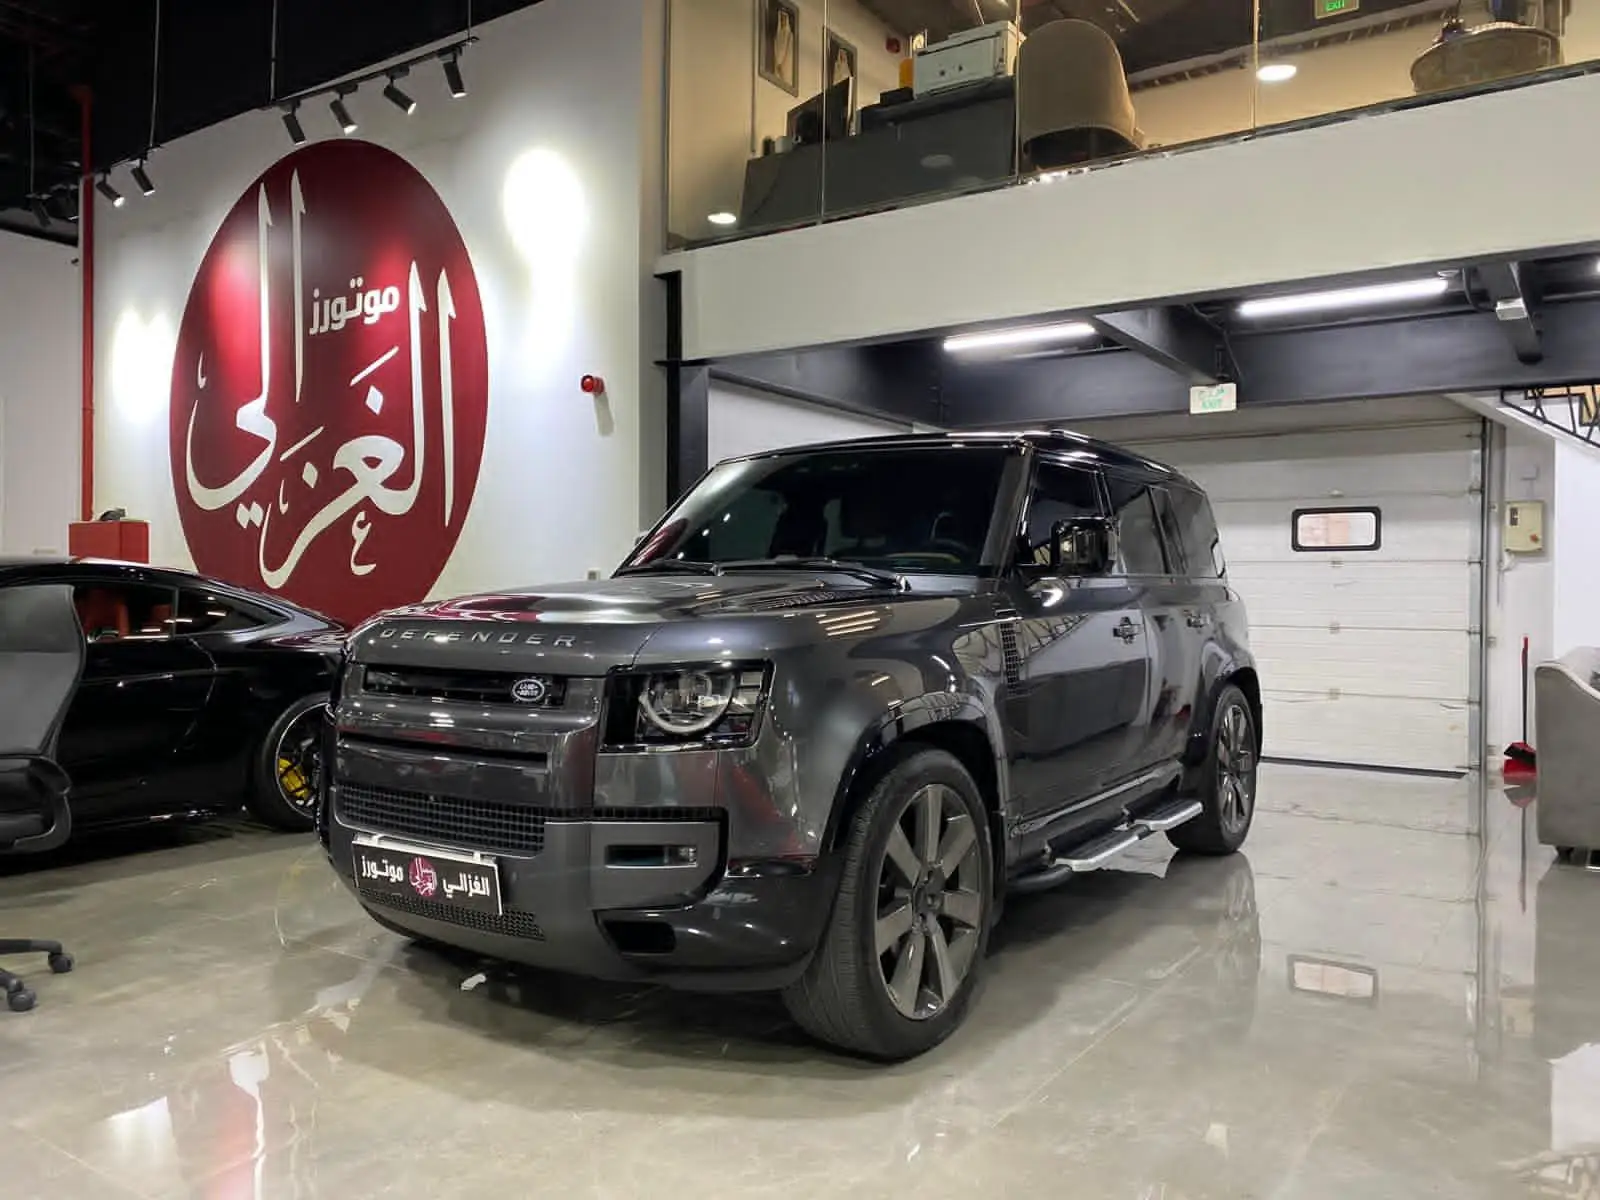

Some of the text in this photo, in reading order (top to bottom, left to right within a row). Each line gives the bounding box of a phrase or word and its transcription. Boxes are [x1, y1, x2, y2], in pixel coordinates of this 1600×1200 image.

[308, 277, 400, 336] موتورز
[379, 627, 577, 648] DEFENDER
[360, 855, 404, 883] موتورز
